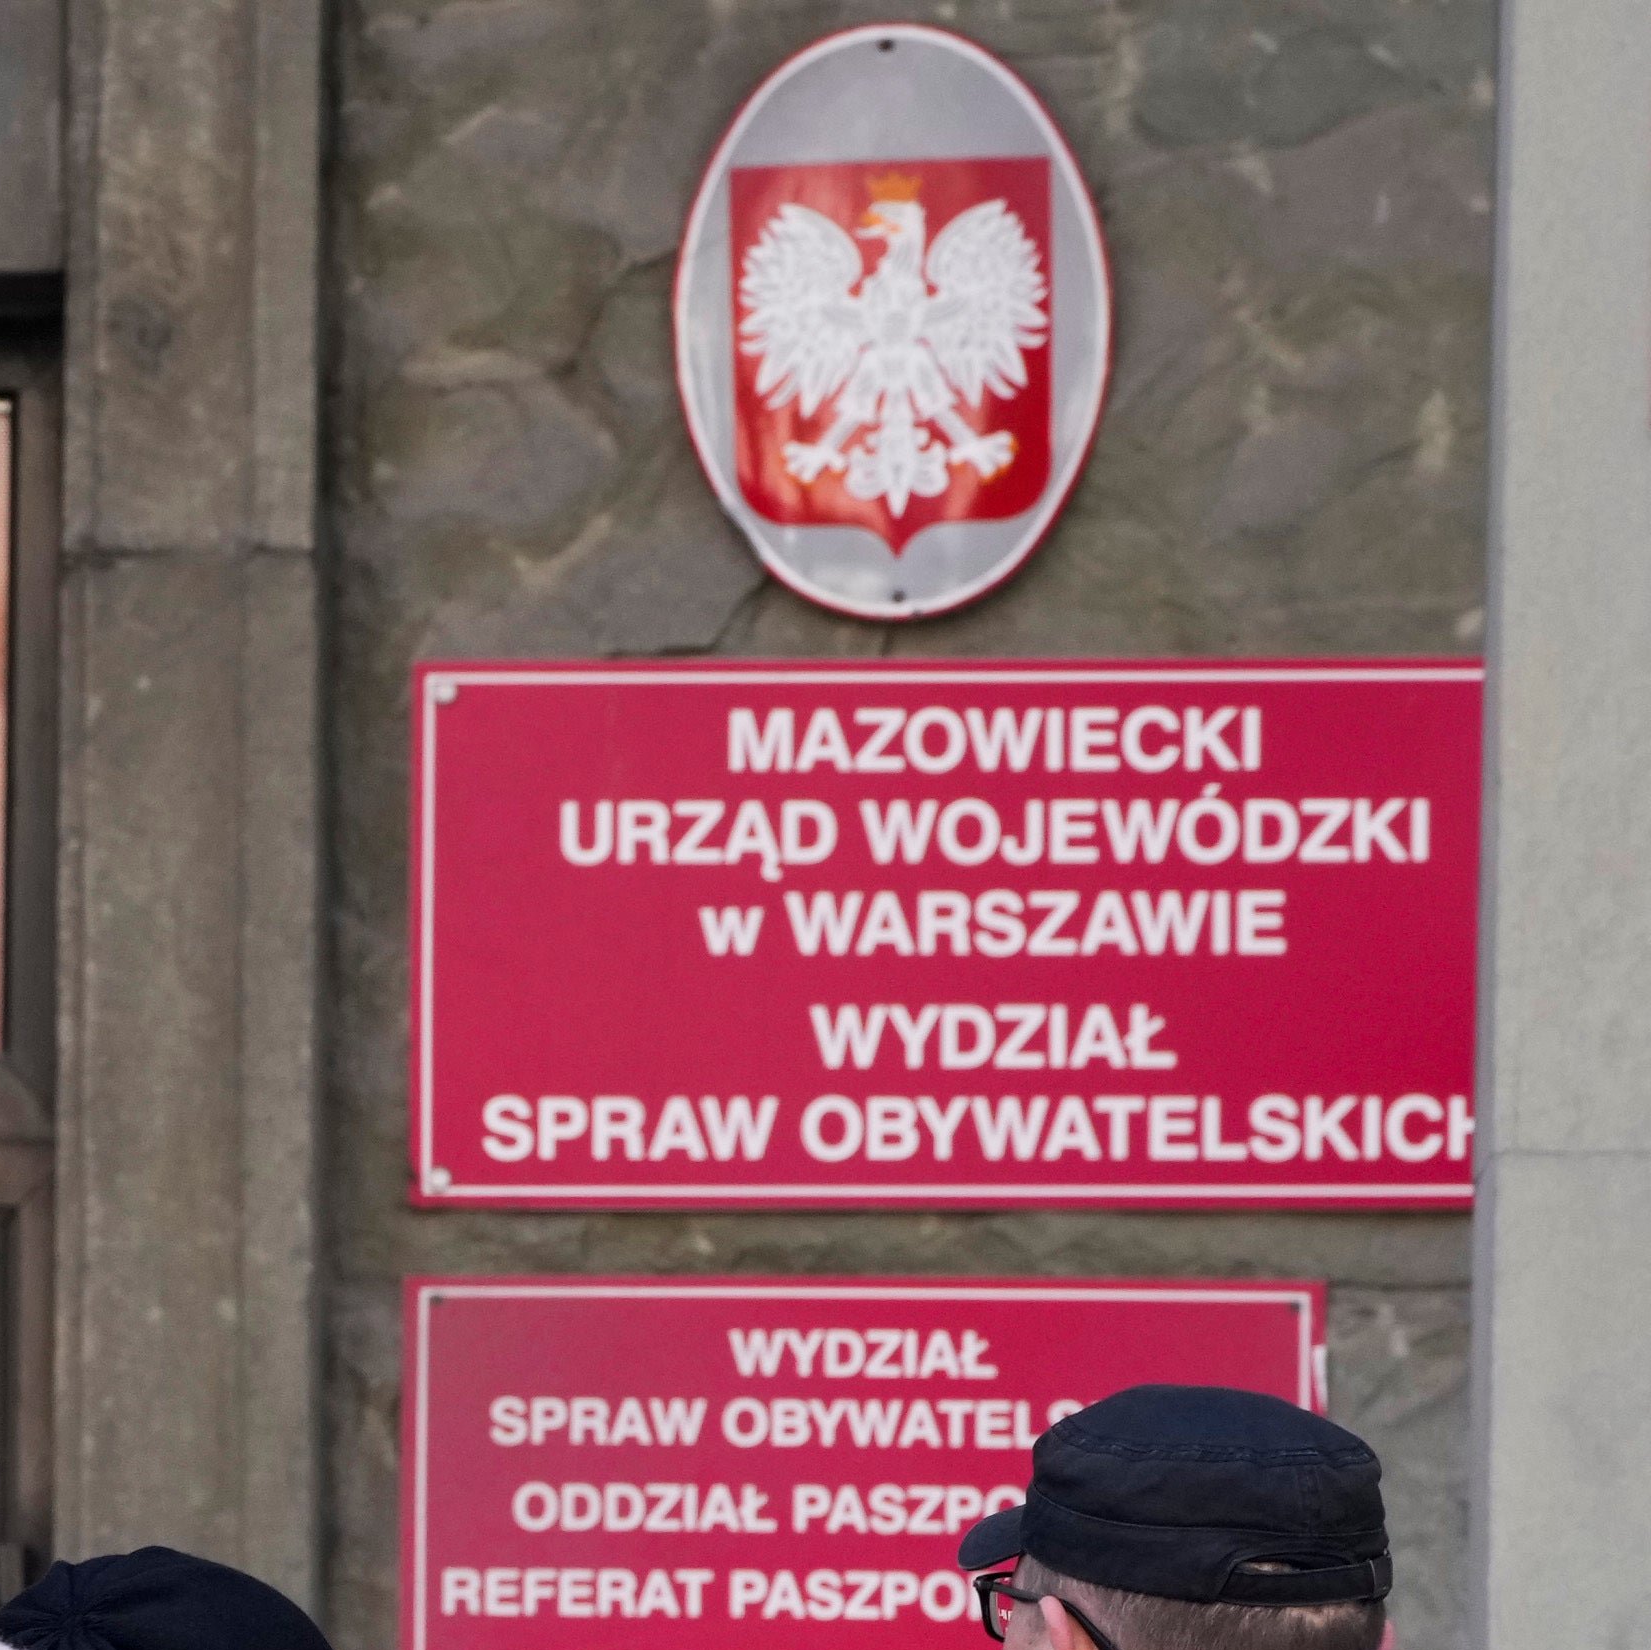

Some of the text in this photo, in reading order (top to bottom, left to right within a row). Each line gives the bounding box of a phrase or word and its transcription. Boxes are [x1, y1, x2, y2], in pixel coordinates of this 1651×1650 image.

[726, 704, 1262, 776] MAZOWIECKI
[559, 783, 1431, 883] URZĄD WOJEWÓDZKI
[697, 888, 1288, 959] w WARSZAWIE
[809, 1002, 1178, 1071] WYDZIAŁ
[482, 1093, 780, 1164] SPRAW
[728, 1326, 999, 1381] WYDZIAŁ
[489, 1395, 709, 1448] SPRAW
[511, 1480, 779, 1536] ODDZIAŁ
[441, 1566, 715, 1620] REFERAT
